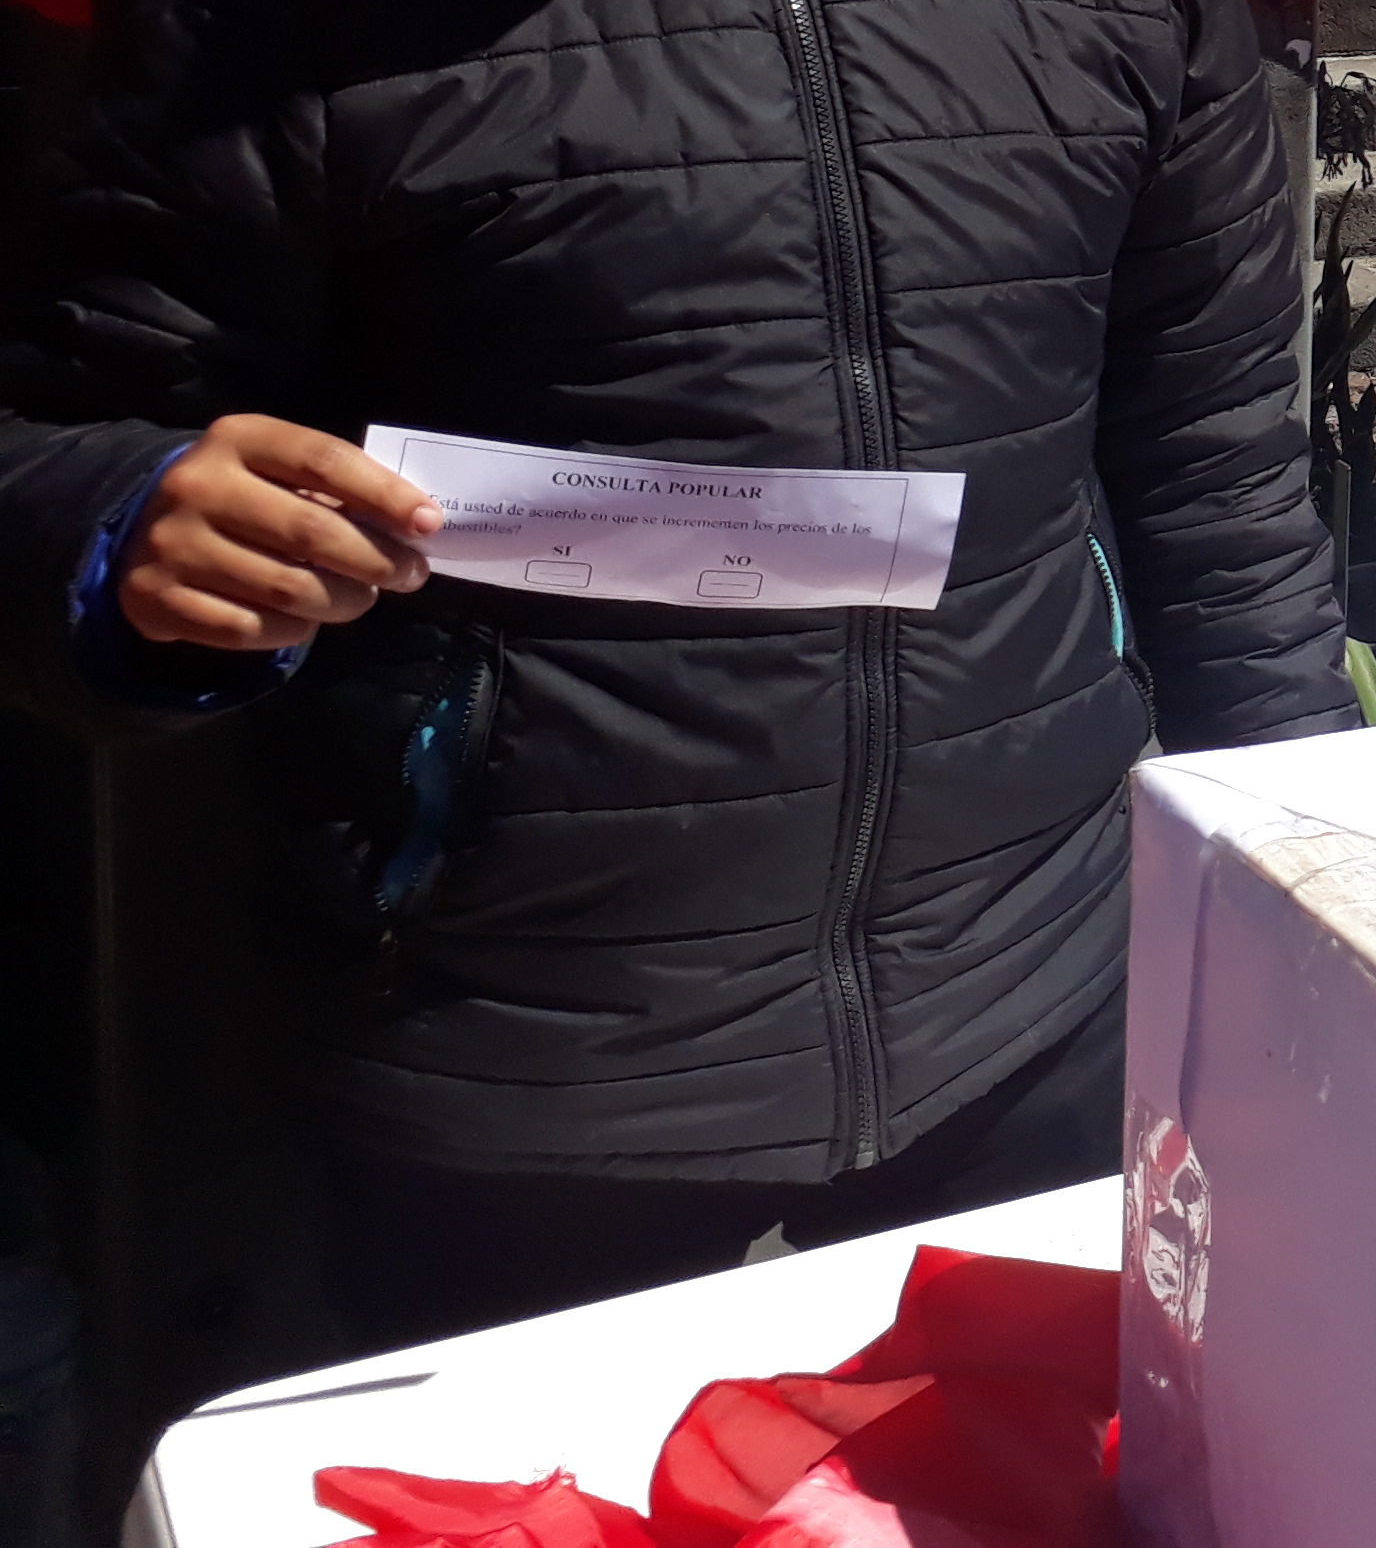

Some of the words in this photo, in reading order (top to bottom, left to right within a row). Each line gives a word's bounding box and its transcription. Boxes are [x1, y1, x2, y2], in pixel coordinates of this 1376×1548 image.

[551, 470, 661, 494] CONSULTA
[668, 481, 764, 500] POPULAR
[464, 502, 502, 515] usted
[507, 503, 525, 517] de
[529, 507, 587, 521] acuerdo
[590, 512, 608, 521] en
[612, 513, 639, 525] que
[642, 515, 659, 525] se
[662, 514, 749, 531] incrementen
[753, 519, 775, 531] los
[777, 521, 828, 535] precios
[831, 522, 848, 535] de
[852, 523, 872, 535] los
[552, 544, 573, 557] SI
[722, 553, 753, 568] NO
